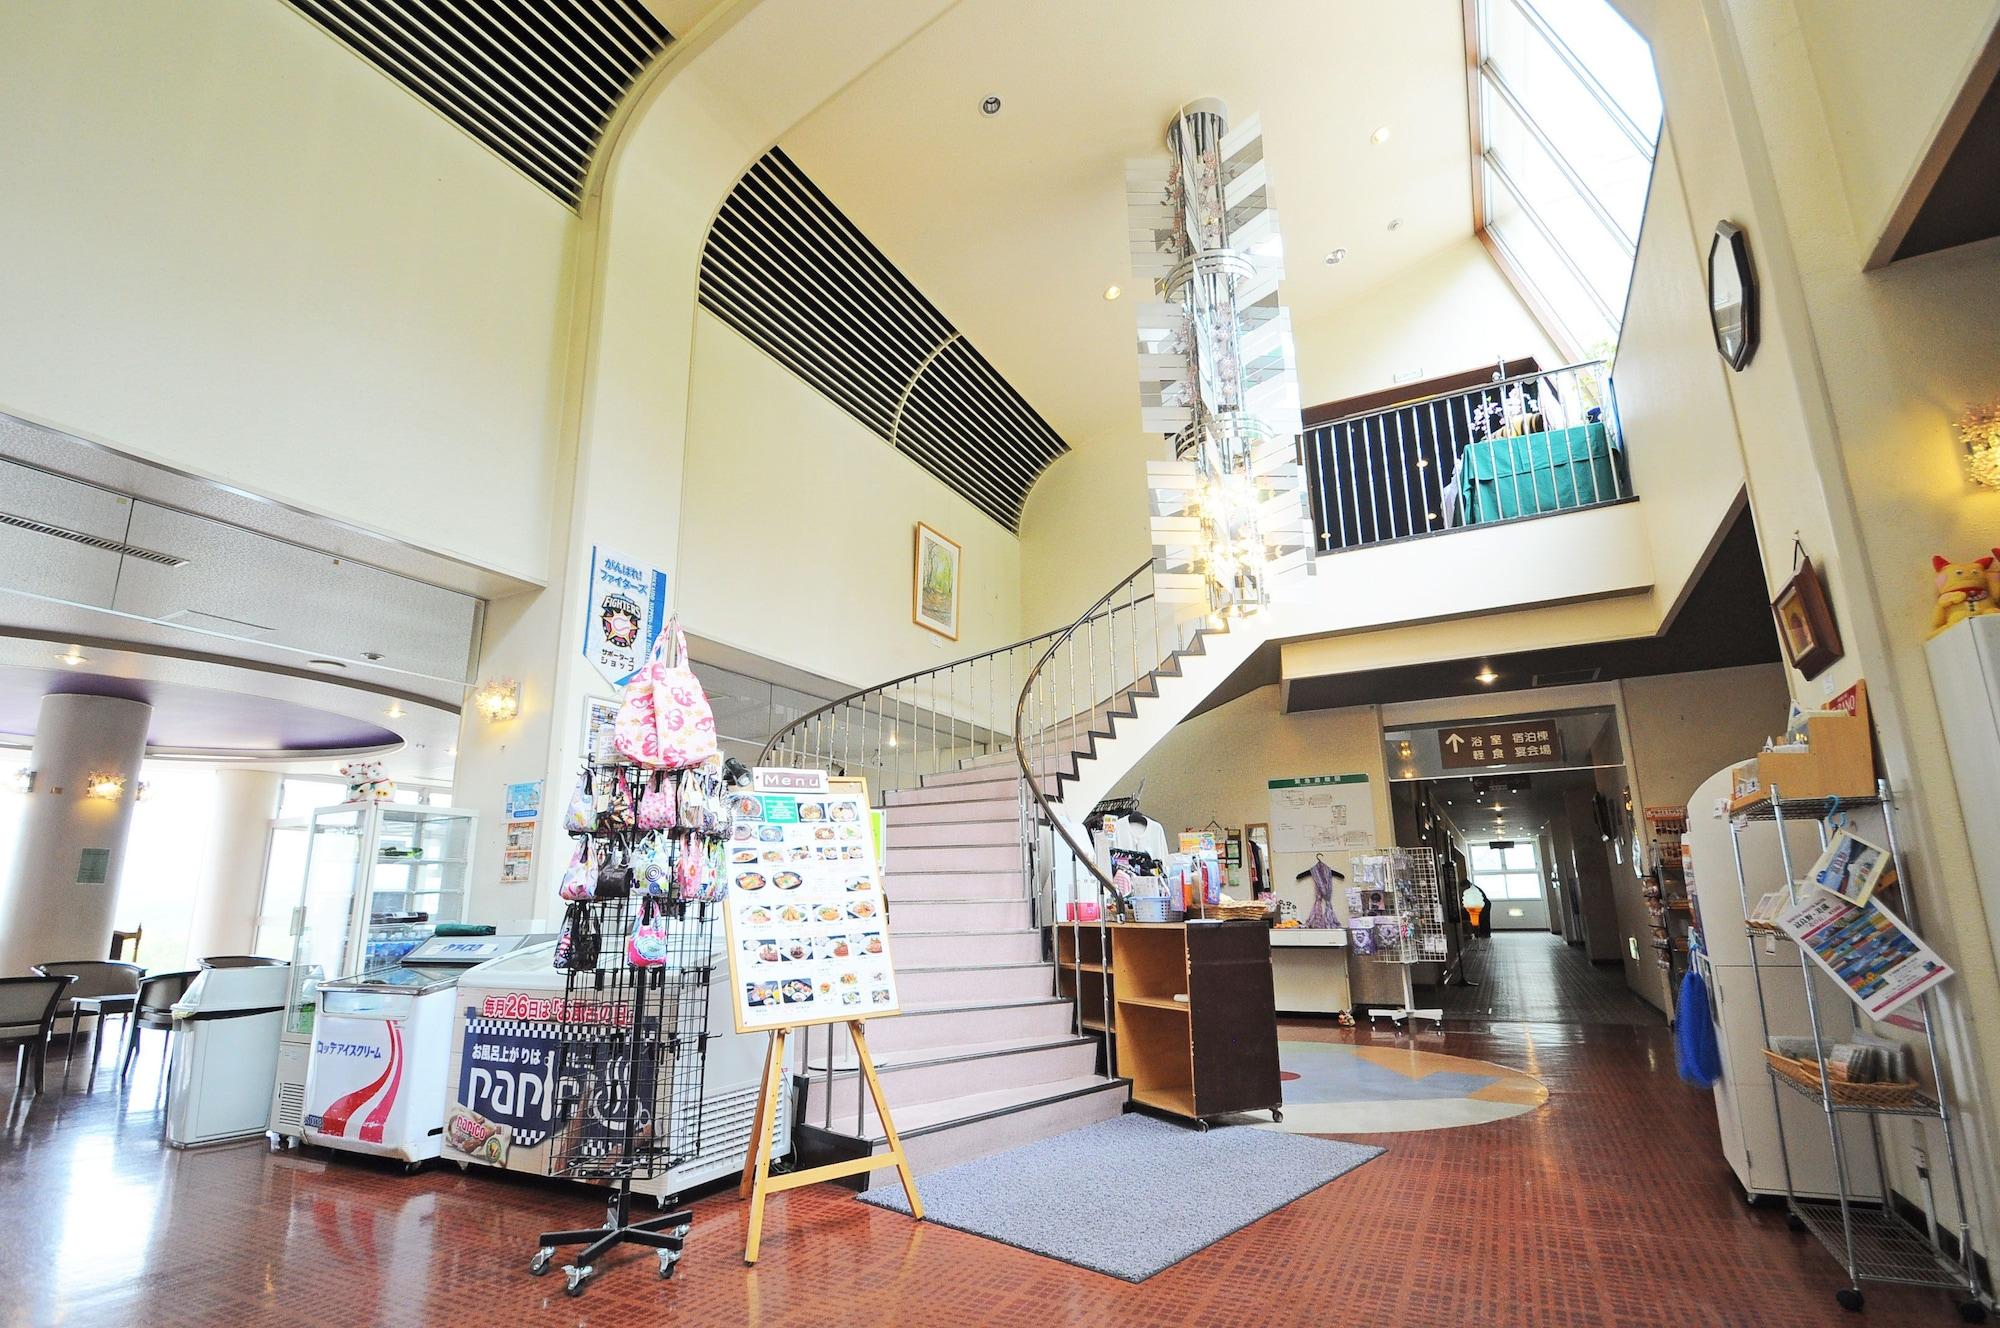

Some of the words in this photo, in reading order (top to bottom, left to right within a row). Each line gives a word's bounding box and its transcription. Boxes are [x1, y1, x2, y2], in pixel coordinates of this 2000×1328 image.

[600, 569, 647, 595] ファイターズ
[603, 596, 641, 618] FIGHTERS
[1512, 731, 1549, 743] 宿泊棟
[1514, 744, 1551, 757] 宴会場
[765, 773, 818, 787] Menu
[317, 1040, 381, 1059] ロッテアイスクリーム
